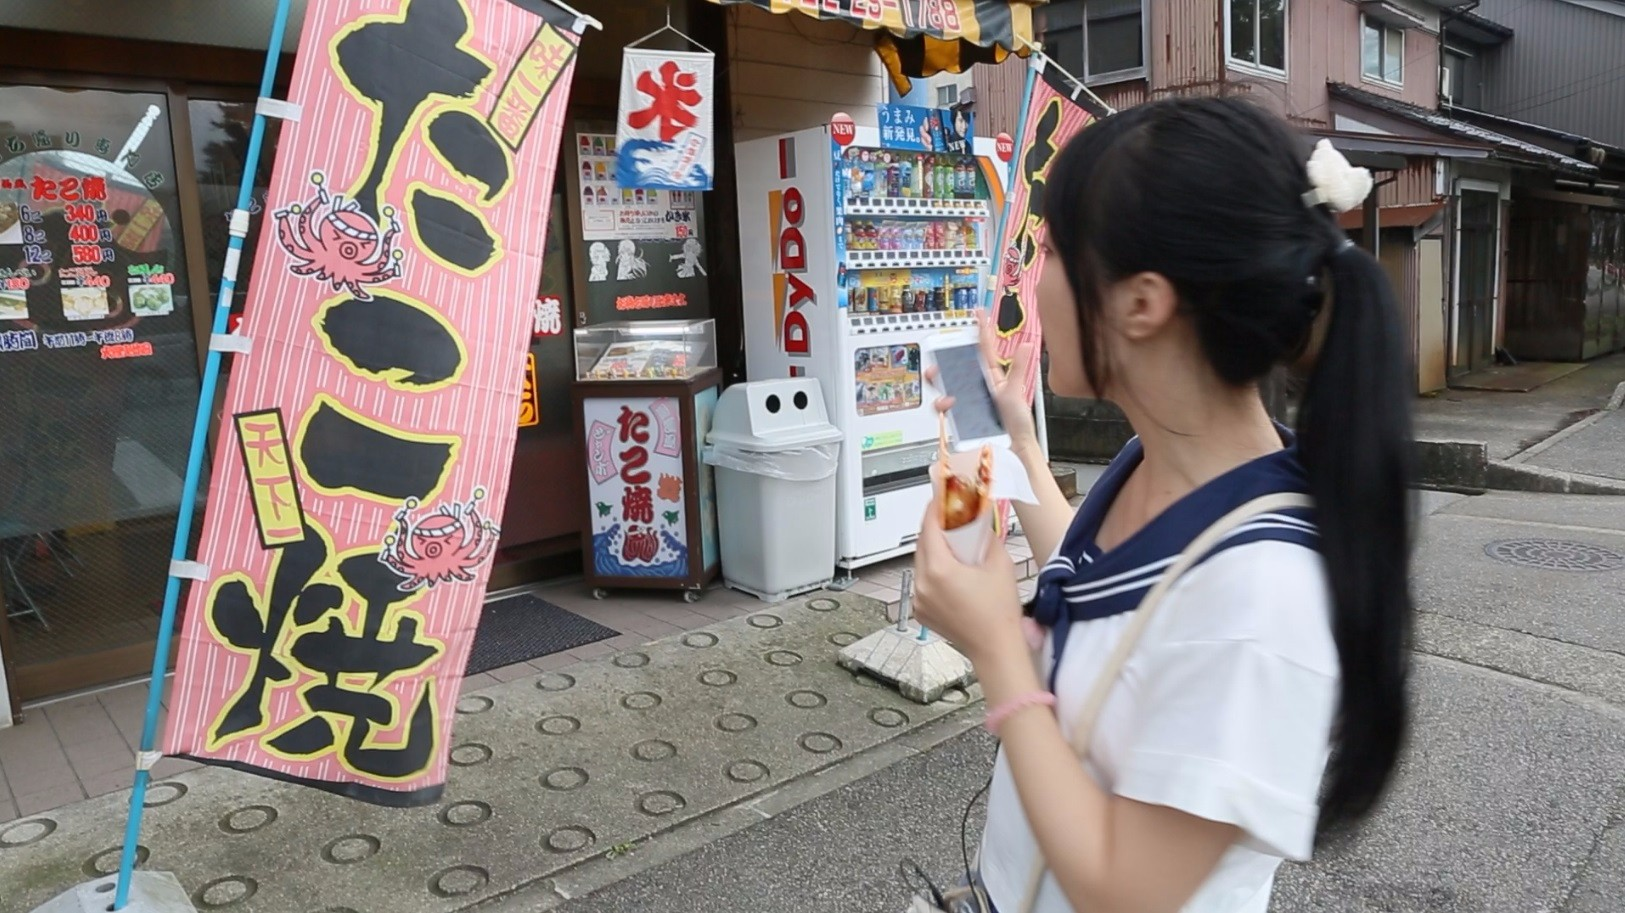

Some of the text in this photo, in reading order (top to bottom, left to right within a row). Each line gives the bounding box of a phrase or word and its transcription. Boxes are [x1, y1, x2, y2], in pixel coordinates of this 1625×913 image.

[497, 40, 568, 143] 味一番
[626, 60, 703, 143] 氷
[880, 106, 916, 125] うまみ
[832, 122, 854, 136] NEW
[883, 125, 921, 144] 新発見。
[996, 142, 1013, 154] NEW
[64, 204, 109, 224] 340円
[69, 224, 112, 243] 400円
[616, 404, 655, 525] たこ焼
[244, 422, 302, 539] 天下一
